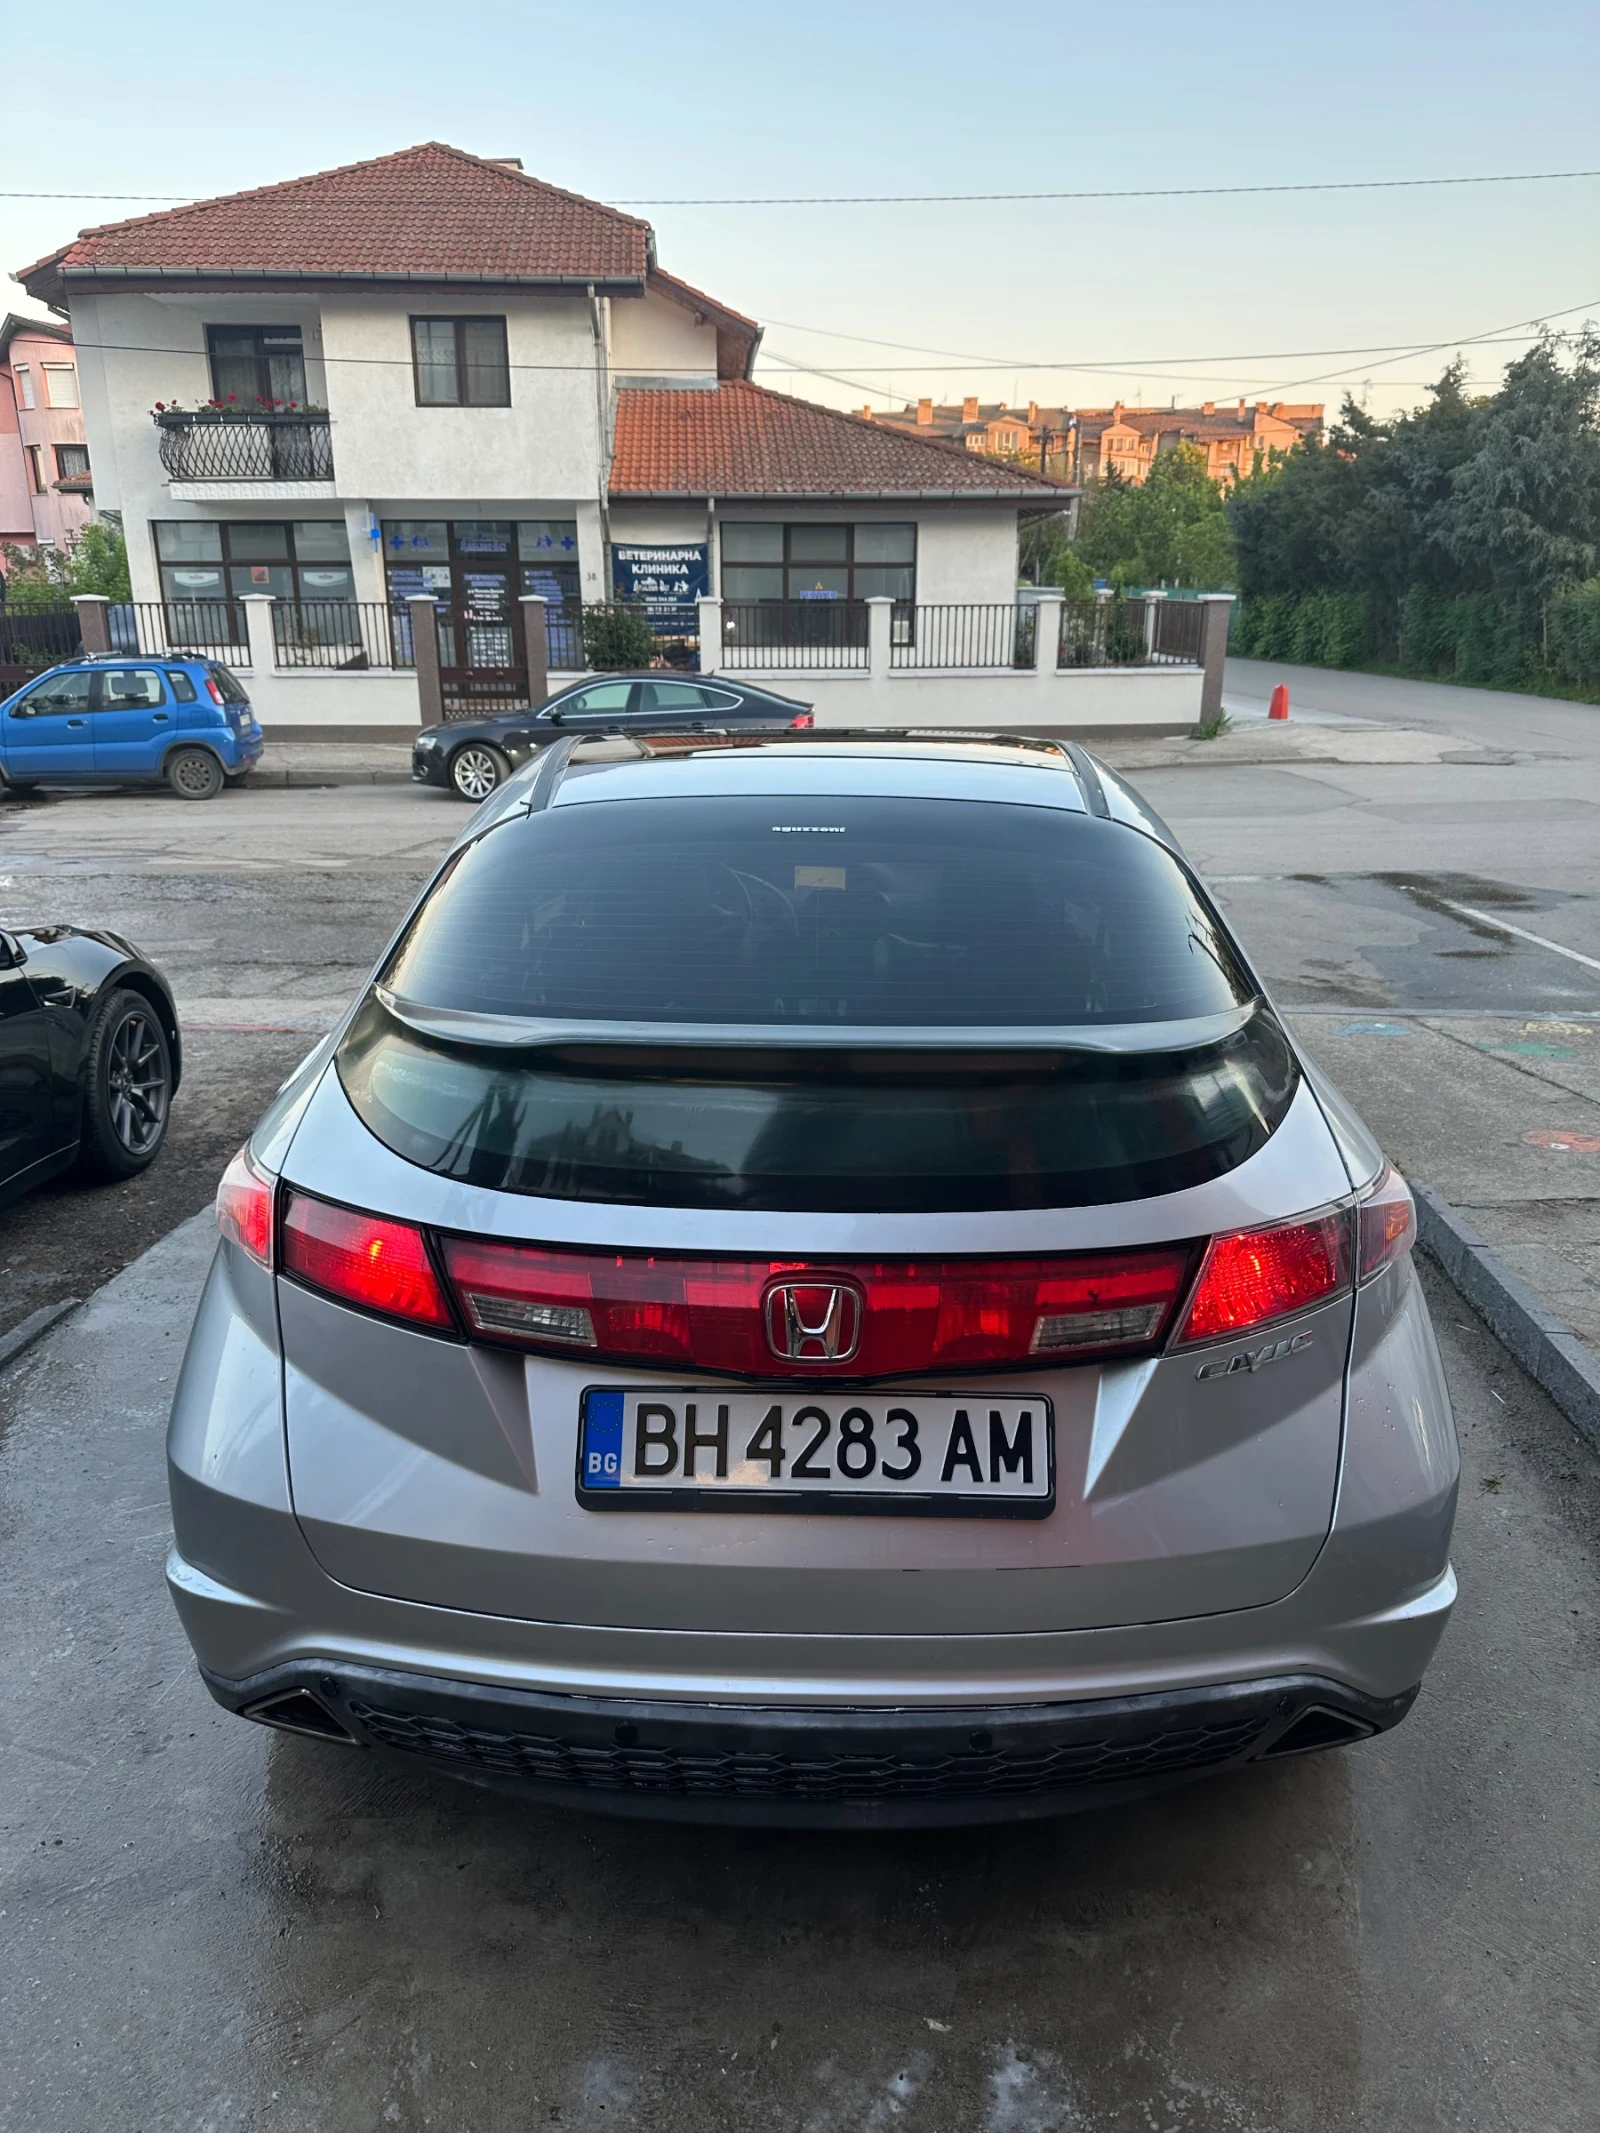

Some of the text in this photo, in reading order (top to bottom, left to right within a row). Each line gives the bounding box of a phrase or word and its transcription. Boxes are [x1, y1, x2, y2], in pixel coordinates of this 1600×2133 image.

[618, 550, 702, 561] ВЕТЕРИНАРНА
[631, 563, 689, 574] КЛИНИКА
[634, 1402, 1034, 1483] BH 4283 AM
[588, 1452, 618, 1474] BG
